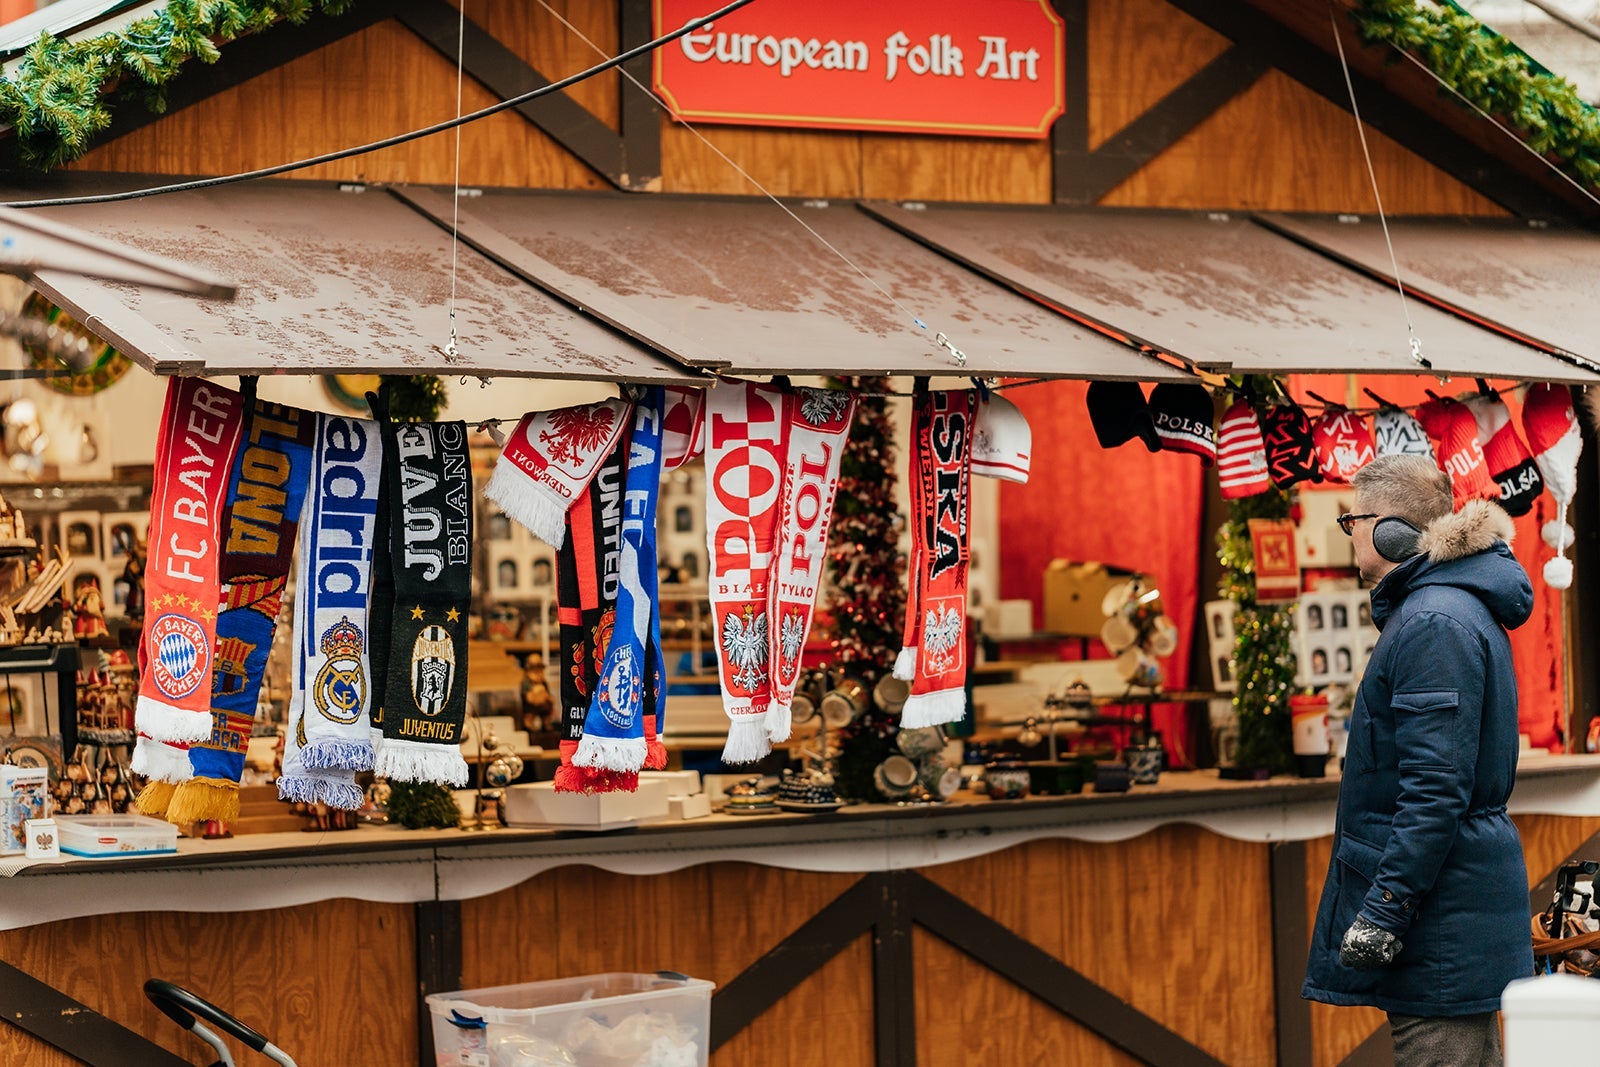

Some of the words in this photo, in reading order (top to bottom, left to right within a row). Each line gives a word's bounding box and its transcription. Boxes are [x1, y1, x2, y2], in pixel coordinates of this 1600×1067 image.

[680, 18, 869, 76] European
[975, 36, 1040, 81] Art
[173, 386, 232, 527] BAYER
[166, 532, 209, 583] FC
[597, 465, 620, 600] UNITED
[781, 583, 814, 598] TYLKO
[399, 718, 457, 740] JUVENTUS
